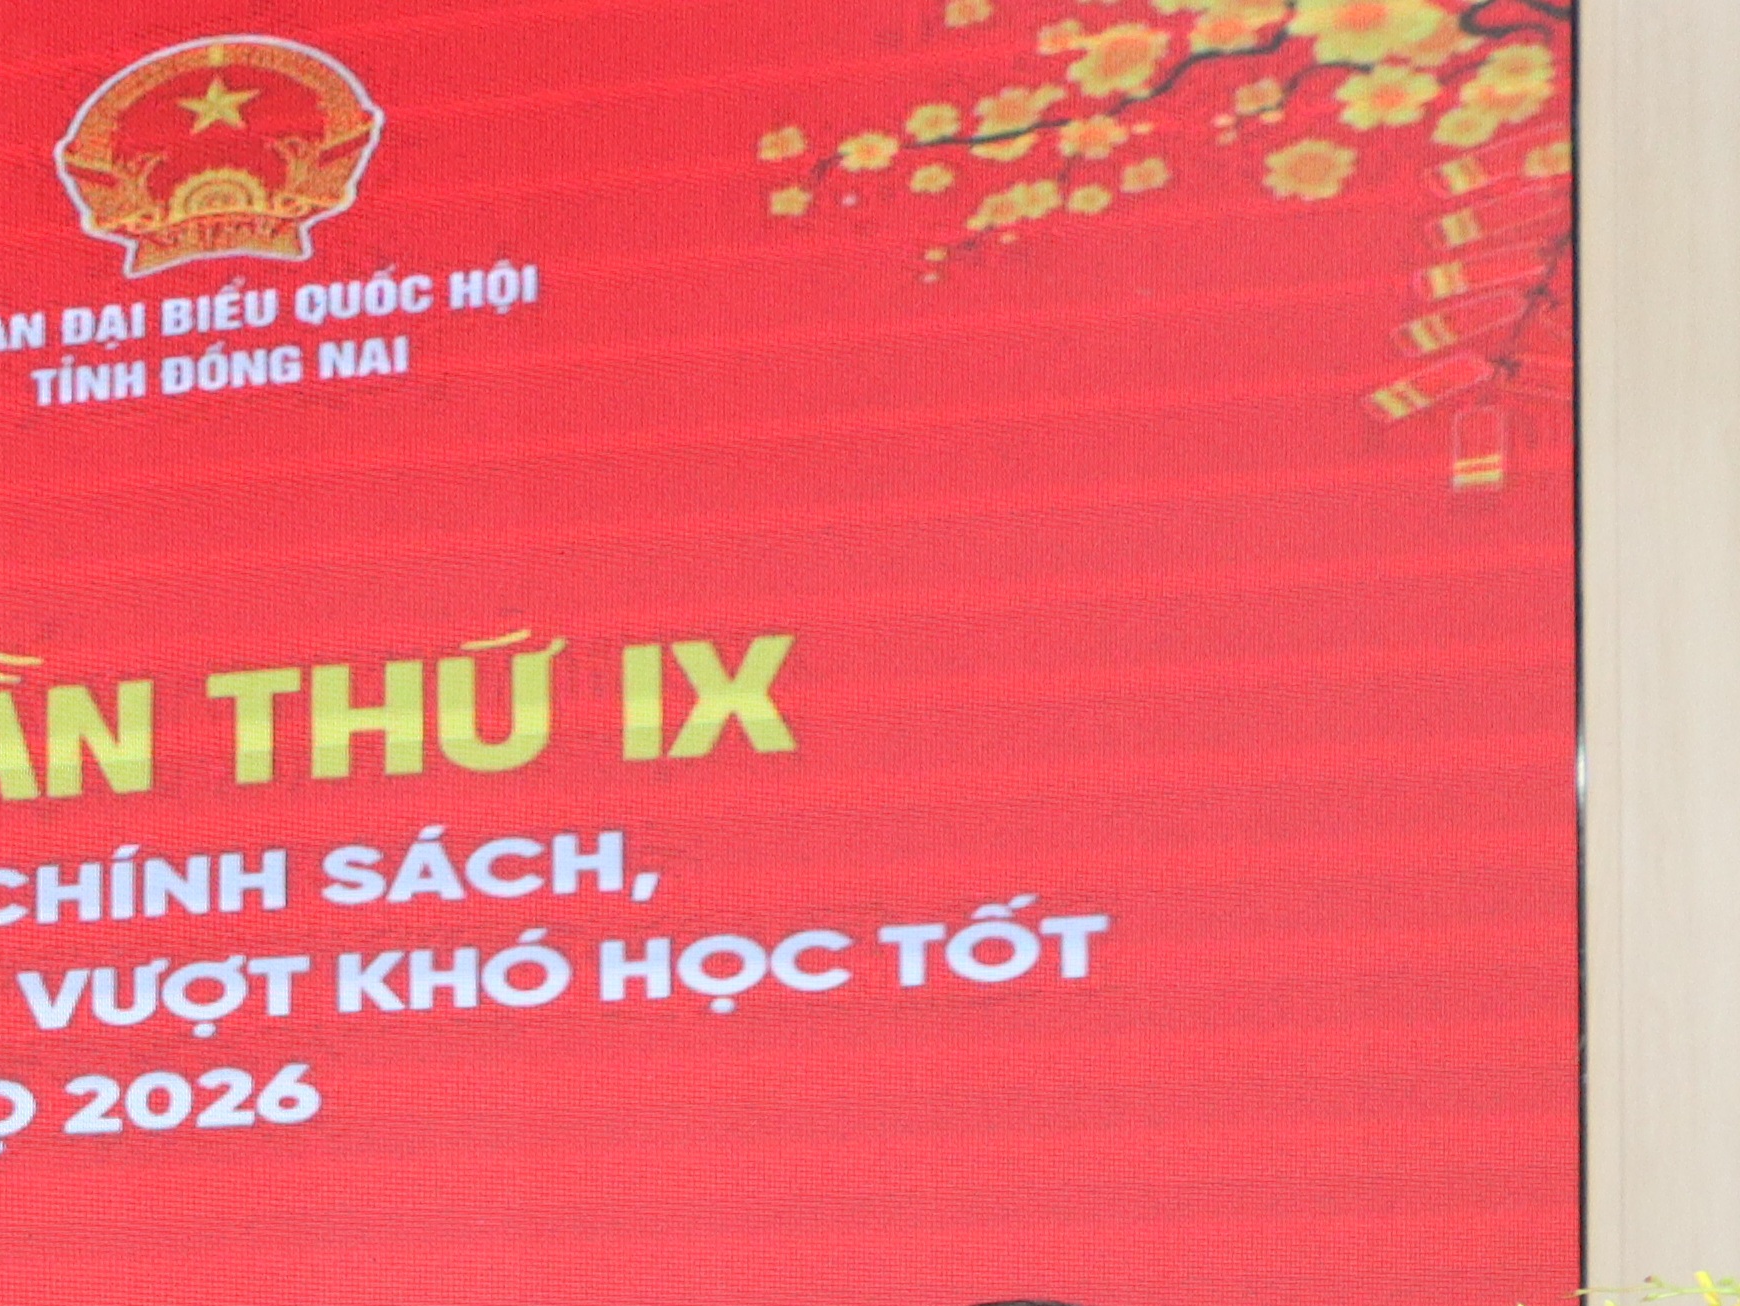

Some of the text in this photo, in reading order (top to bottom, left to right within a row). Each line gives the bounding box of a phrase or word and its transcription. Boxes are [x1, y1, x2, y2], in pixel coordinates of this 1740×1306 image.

[61, 302, 146, 349] ĐẠI
[161, 279, 279, 336] BIỂU
[294, 270, 433, 325] QUỐC
[449, 260, 538, 314] HỘI
[31, 336, 408, 406] TỈNH ĐỒNG NAI
[206, 629, 565, 784] THỨ
[622, 635, 795, 760] IX
[322, 824, 659, 905] SÁCH,
[17, 954, 311, 1038] VƯỢT
[337, 928, 572, 1013] KHÓ
[599, 929, 851, 1014] HỌC
[878, 894, 1109, 987] TỐT
[64, 1063, 321, 1135] 2026
